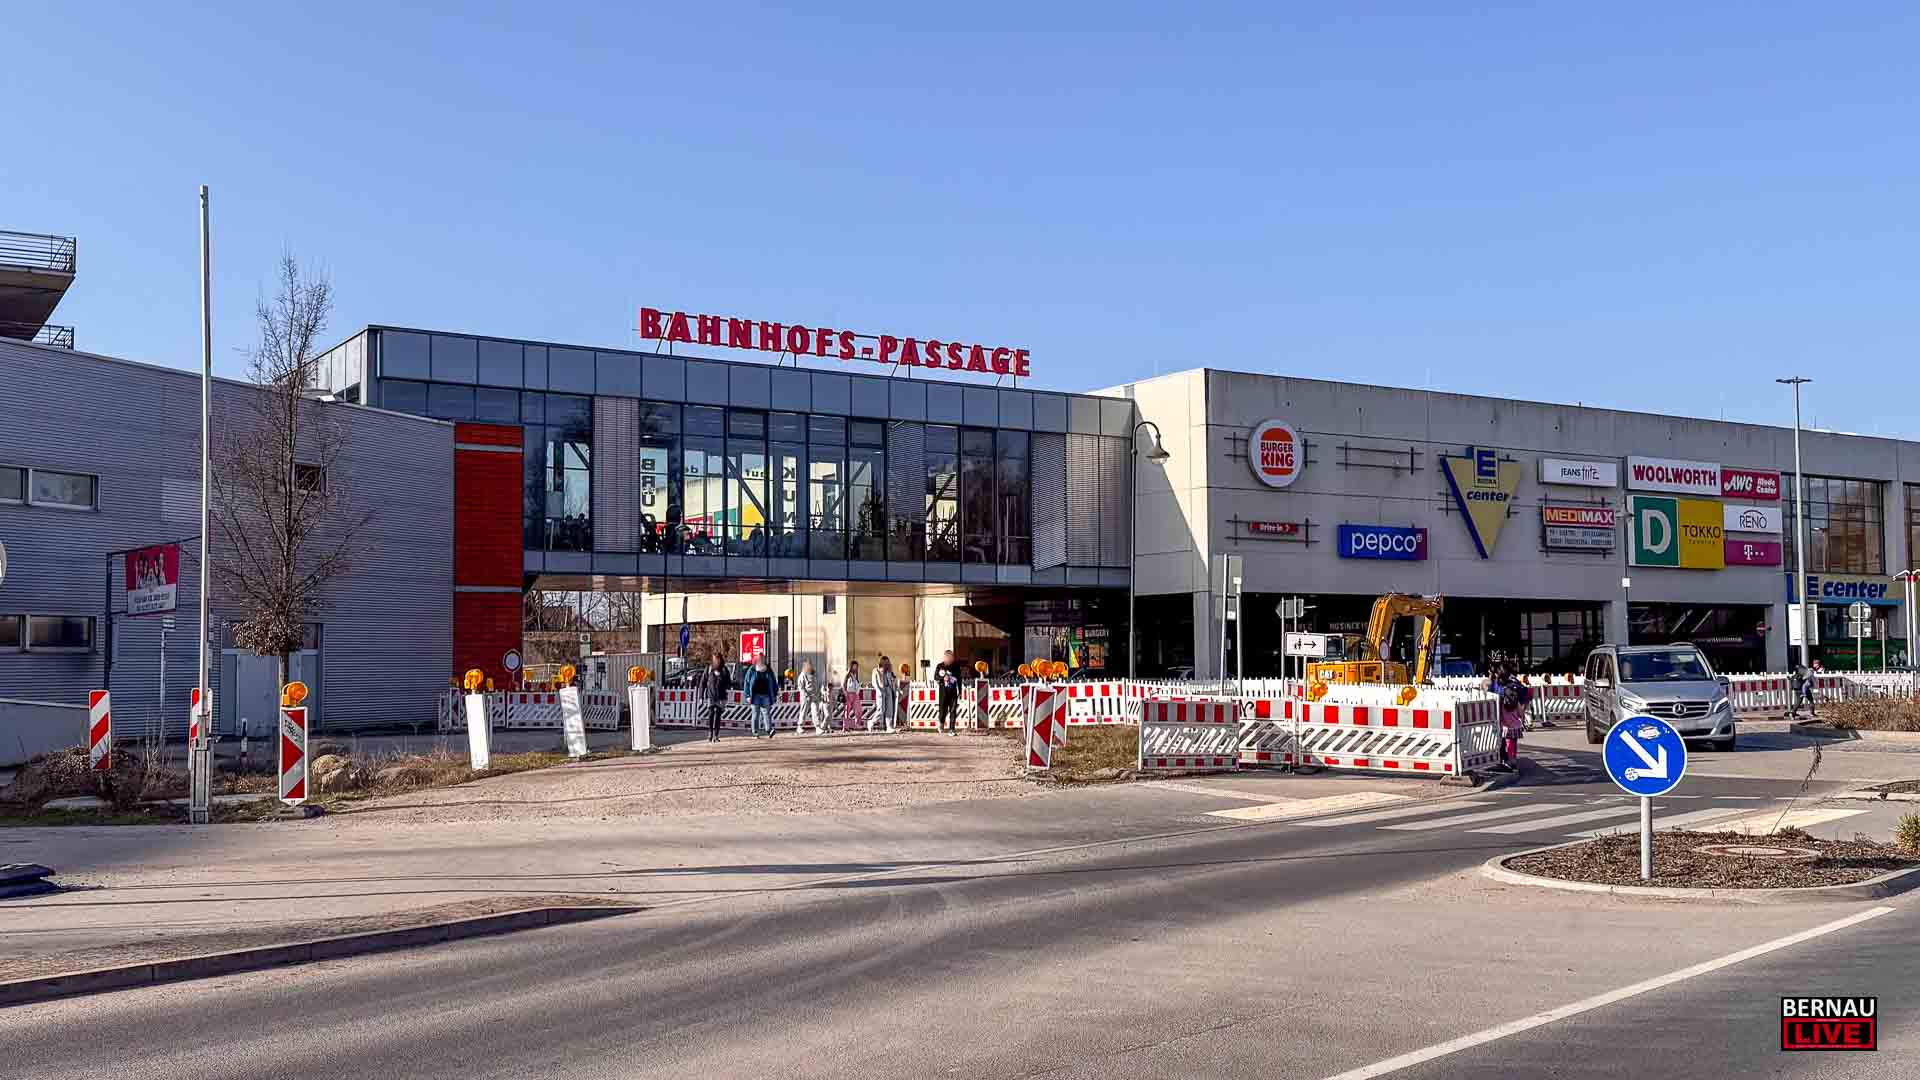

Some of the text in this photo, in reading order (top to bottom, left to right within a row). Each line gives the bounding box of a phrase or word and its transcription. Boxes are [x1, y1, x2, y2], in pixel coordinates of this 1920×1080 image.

[640, 307, 1030, 376] BAHNHOFS-PASSAGE
[1260, 442, 1293, 453] BURGER
[1260, 452, 1294, 466] KING
[1477, 450, 1496, 477] E
[1561, 467, 1581, 477] JEANS
[1633, 464, 1716, 486] WOOLWORTH
[1724, 475, 1753, 492] AWG
[1467, 490, 1509, 502] center
[1546, 508, 1613, 524] MEDIMAX
[1739, 514, 1767, 529] RENO
[1642, 509, 1671, 554] D
[1351, 532, 1416, 555] pepco
[1823, 580, 1888, 598] center
